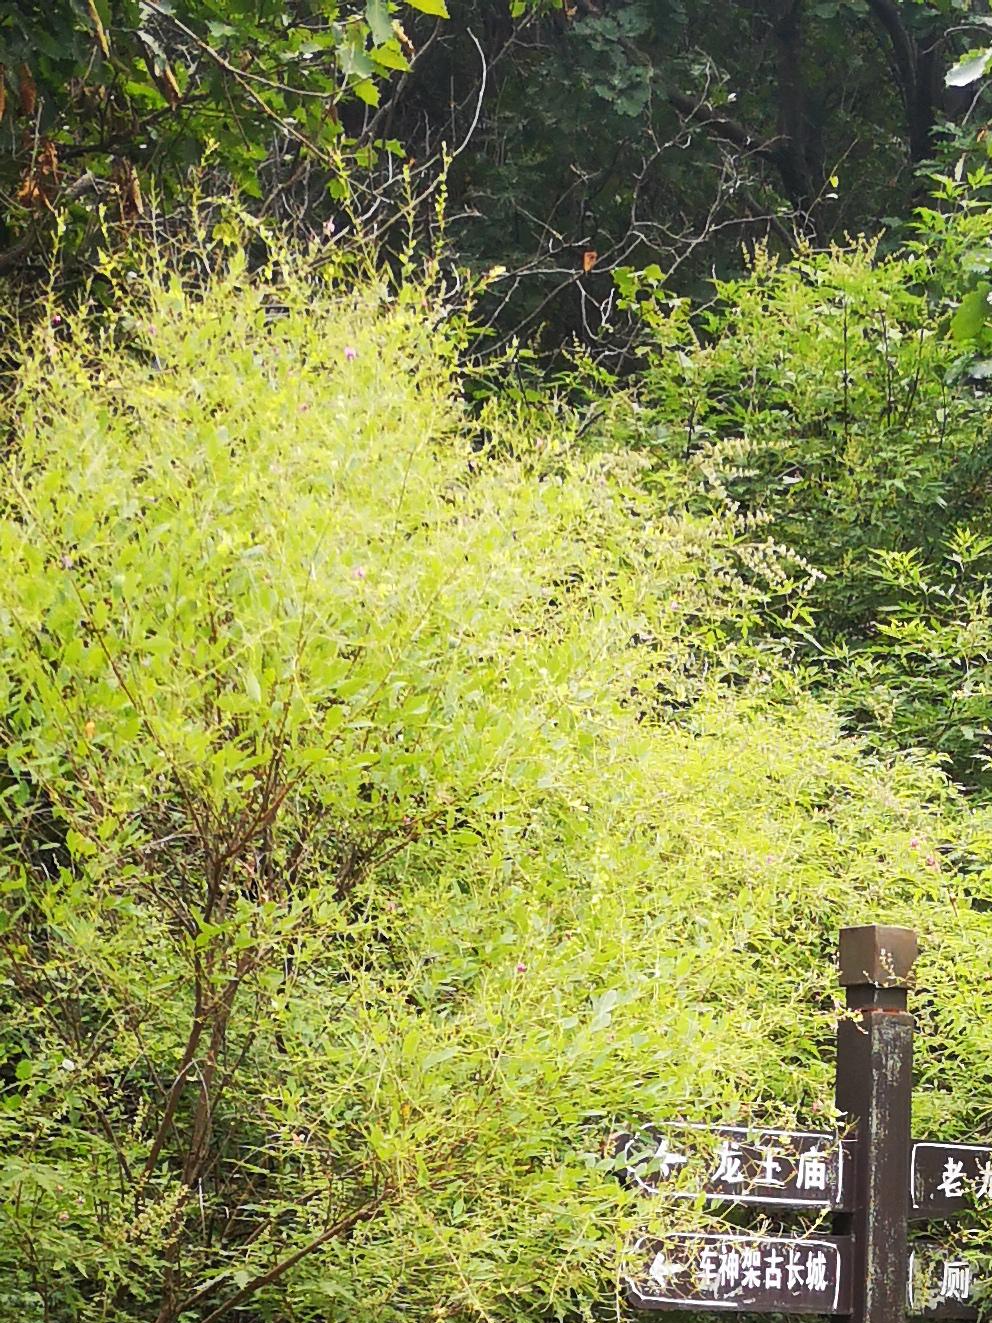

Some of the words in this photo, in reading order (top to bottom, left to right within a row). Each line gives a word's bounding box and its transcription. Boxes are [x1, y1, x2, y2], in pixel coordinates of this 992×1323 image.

[711, 1141, 826, 1190] 龙王庙
[698, 1245, 828, 1291] 车神架古长城
